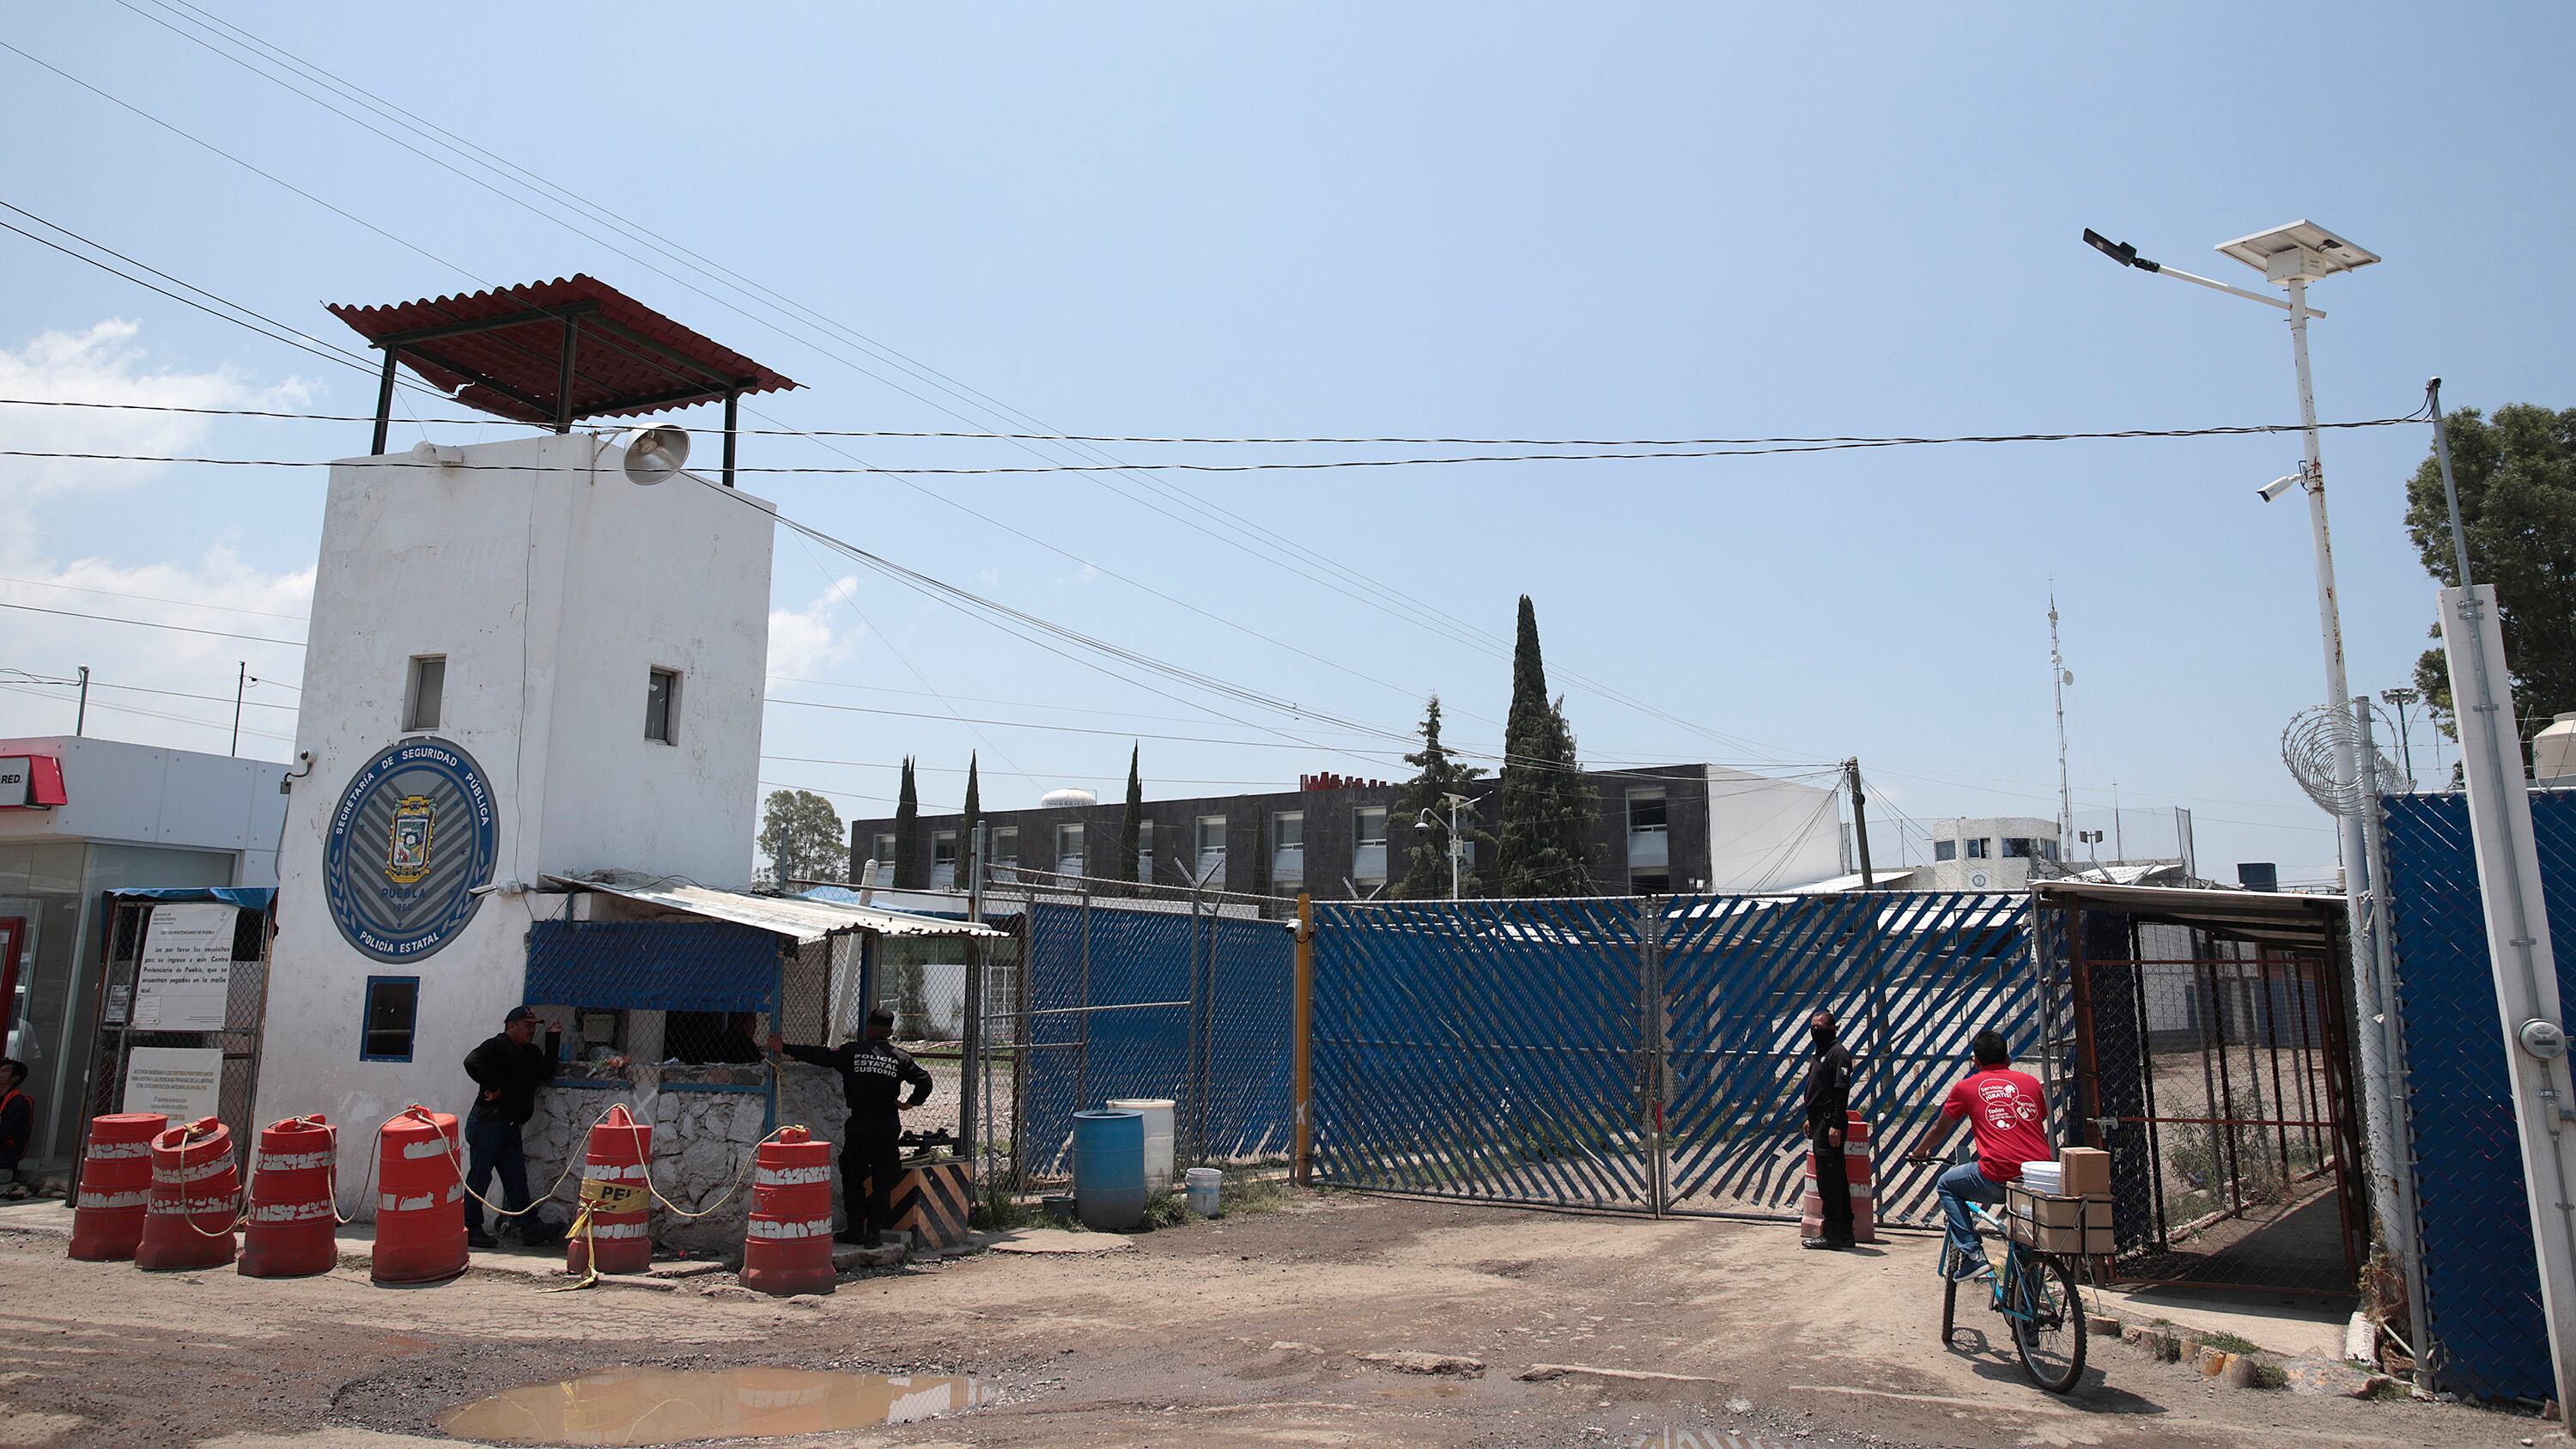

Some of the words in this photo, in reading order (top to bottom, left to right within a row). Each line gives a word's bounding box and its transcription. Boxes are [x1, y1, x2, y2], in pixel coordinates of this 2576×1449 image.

[336, 771, 374, 835] SECRETARÍA
[381, 756, 394, 770] DE
[402, 747, 458, 767] SEGURIDAD
[465, 772, 489, 826] PÚBLICA
[381, 888, 425, 898] PUEBLA
[359, 931, 394, 953] POLICÍA
[399, 932, 440, 953] ESTATAL
[854, 1059, 898, 1072] ESTATAL
[854, 1066, 897, 1078] CUSTODIO
[1985, 1092, 2012, 1102] ¡GRATIS!
